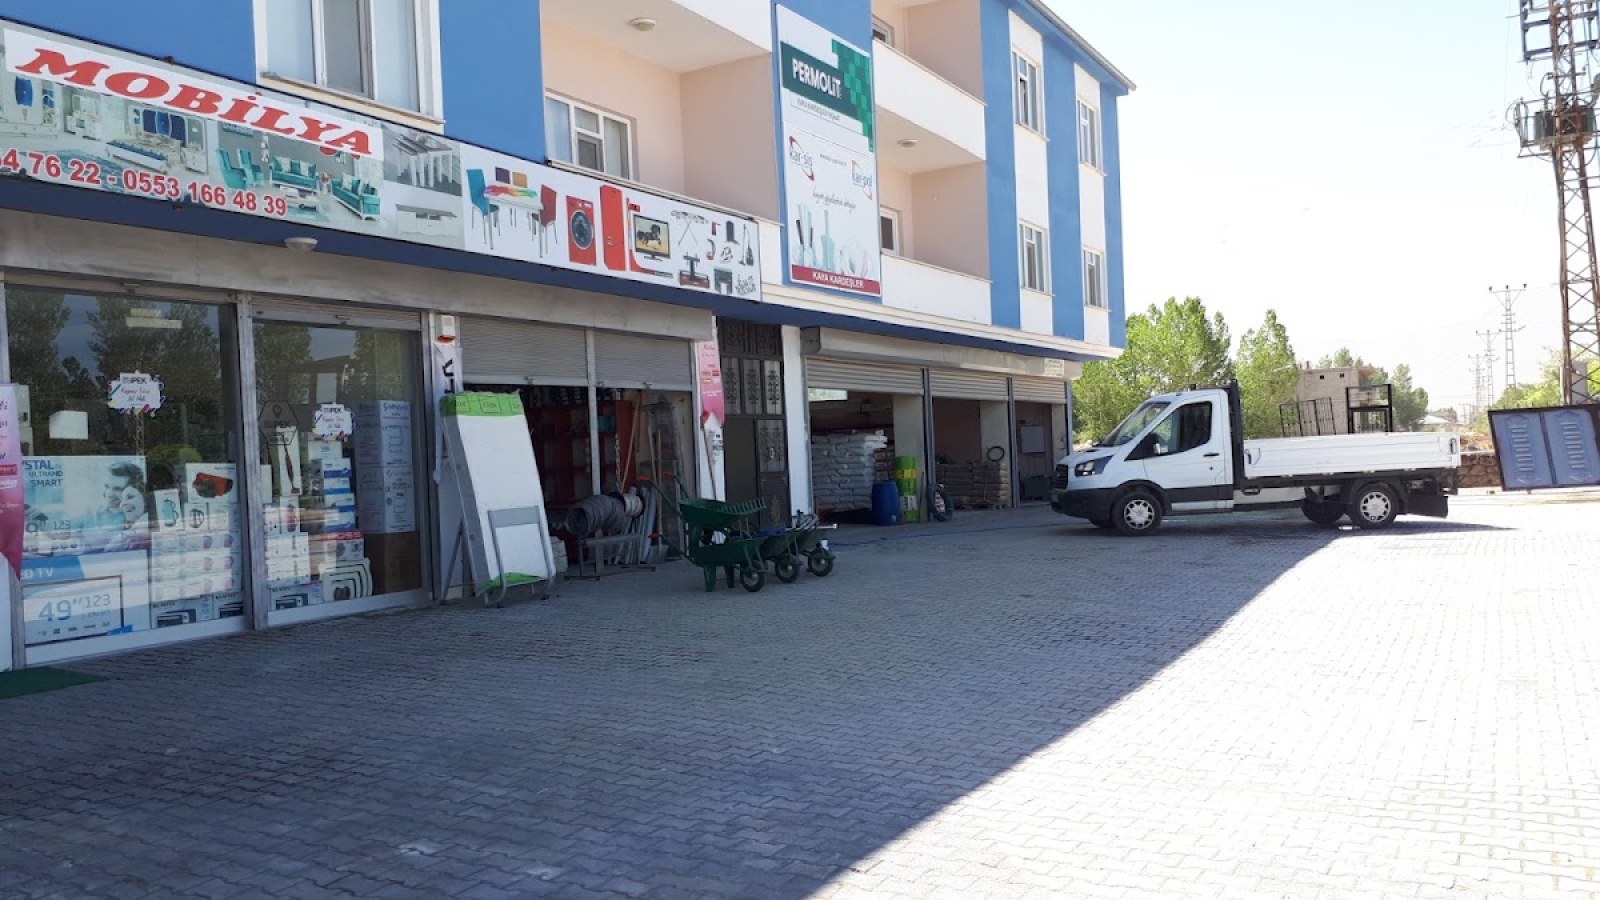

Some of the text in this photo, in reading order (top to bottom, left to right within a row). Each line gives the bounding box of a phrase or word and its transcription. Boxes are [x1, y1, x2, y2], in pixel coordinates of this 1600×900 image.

[15, 48, 373, 156] MOBİLYA
[28, 151, 61, 178] 76
[69, 159, 101, 185] 22
[123, 169, 181, 198] 0553
[187, 182, 227, 206] 166
[232, 190, 257, 212] 48
[263, 195, 288, 216] 39
[812, 270, 829, 282] KAYA
